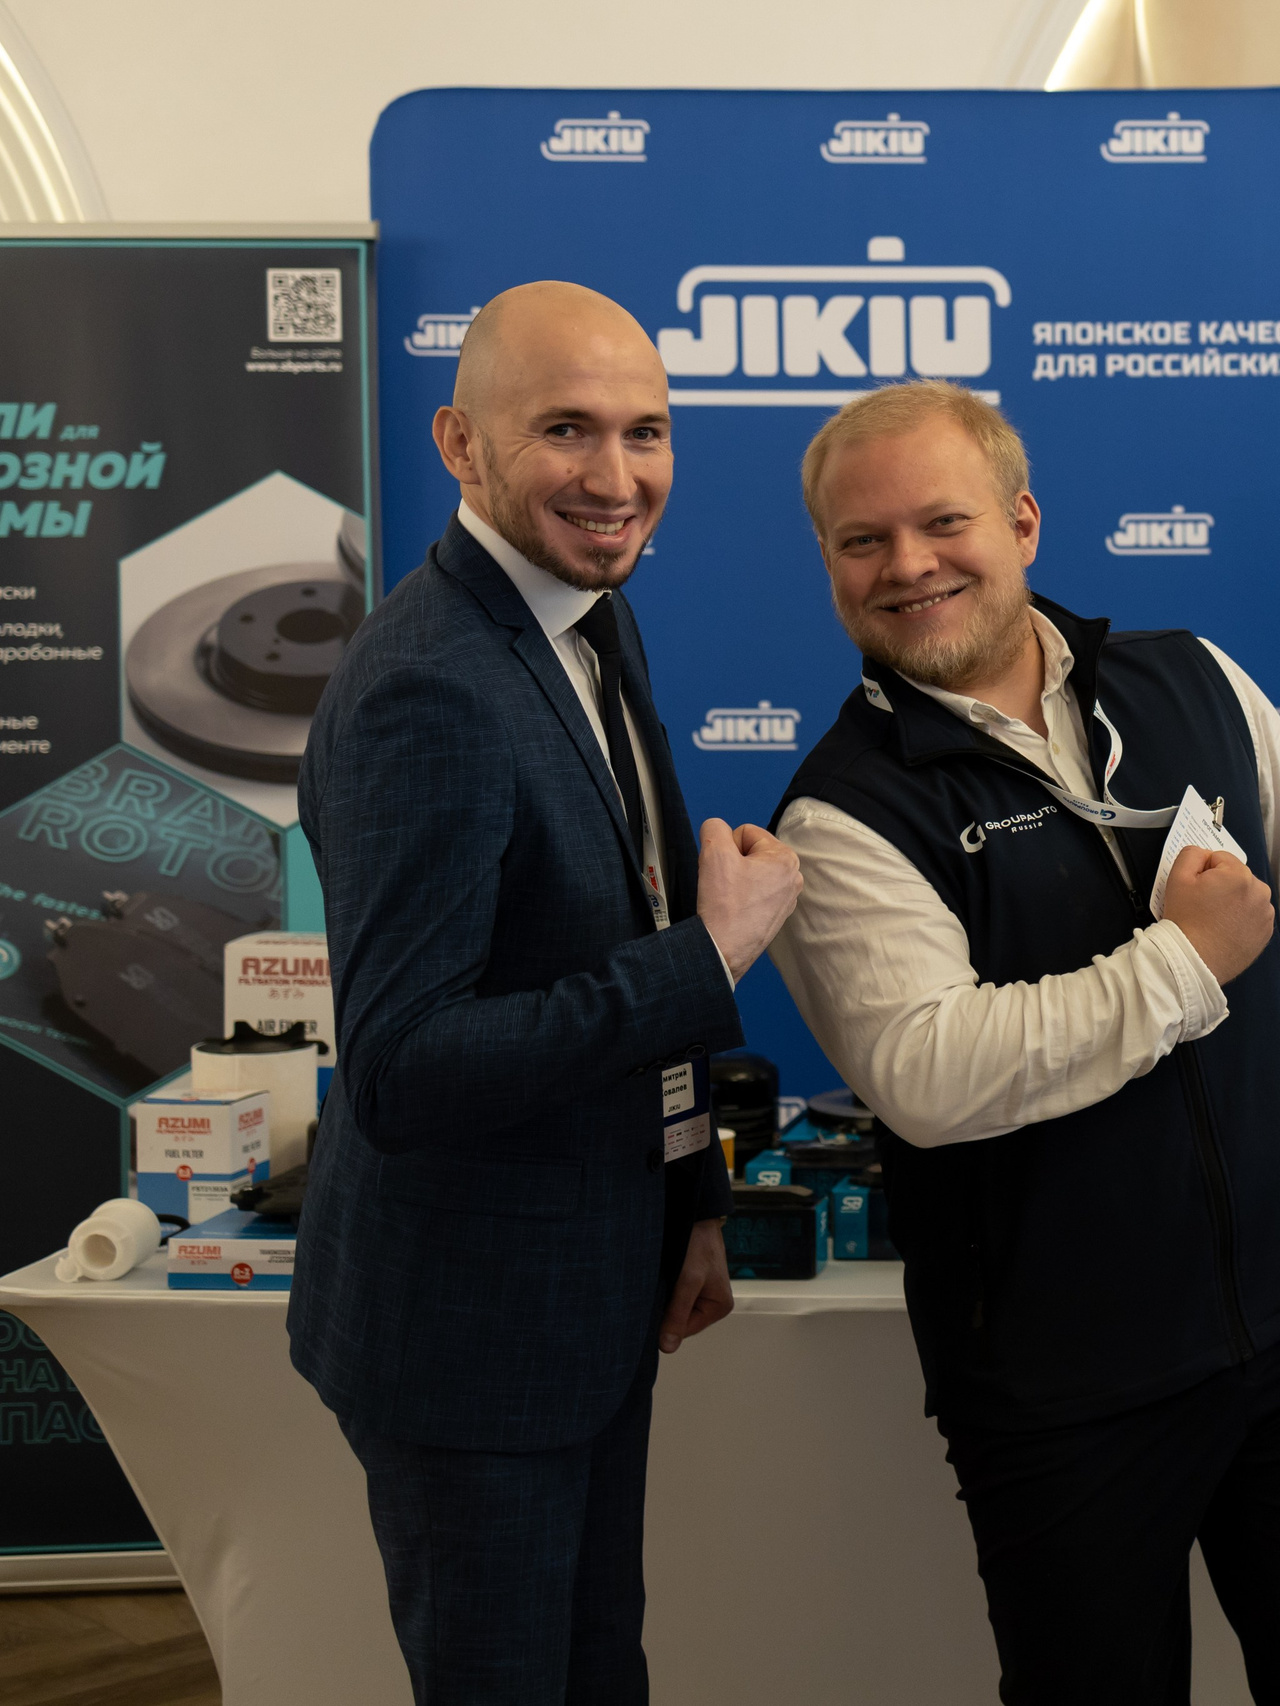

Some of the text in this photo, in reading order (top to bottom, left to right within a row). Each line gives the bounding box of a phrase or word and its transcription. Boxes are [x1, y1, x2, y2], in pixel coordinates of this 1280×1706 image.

[548, 111, 646, 154] JIKIU
[827, 113, 926, 156] JIKIU
[1109, 111, 1206, 155] JIKIU
[658, 236, 992, 378] JIKIU
[1033, 321, 1191, 346] ЯПОНСКОЕ
[1033, 353, 1097, 380] ДЛЯ
[1113, 505, 1210, 548] JIKIU
[0, 586, 37, 600] ски
[0, 622, 64, 639] лодки,
[0, 642, 103, 665] рабанные
[701, 701, 797, 743] JIKIU
[985, 805, 1058, 830] GROUPAUTO
[1011, 821, 1044, 834] Russia
[18, 800, 282, 898] ROTO
[32, 892, 106, 922] fastes
[242, 956, 331, 976] AZUMI
[663, 1068, 687, 1082] митрий
[663, 1084, 687, 1096] овалев
[158, 1116, 211, 1129] AZUMI
[178, 1245, 221, 1255] AZUMI
